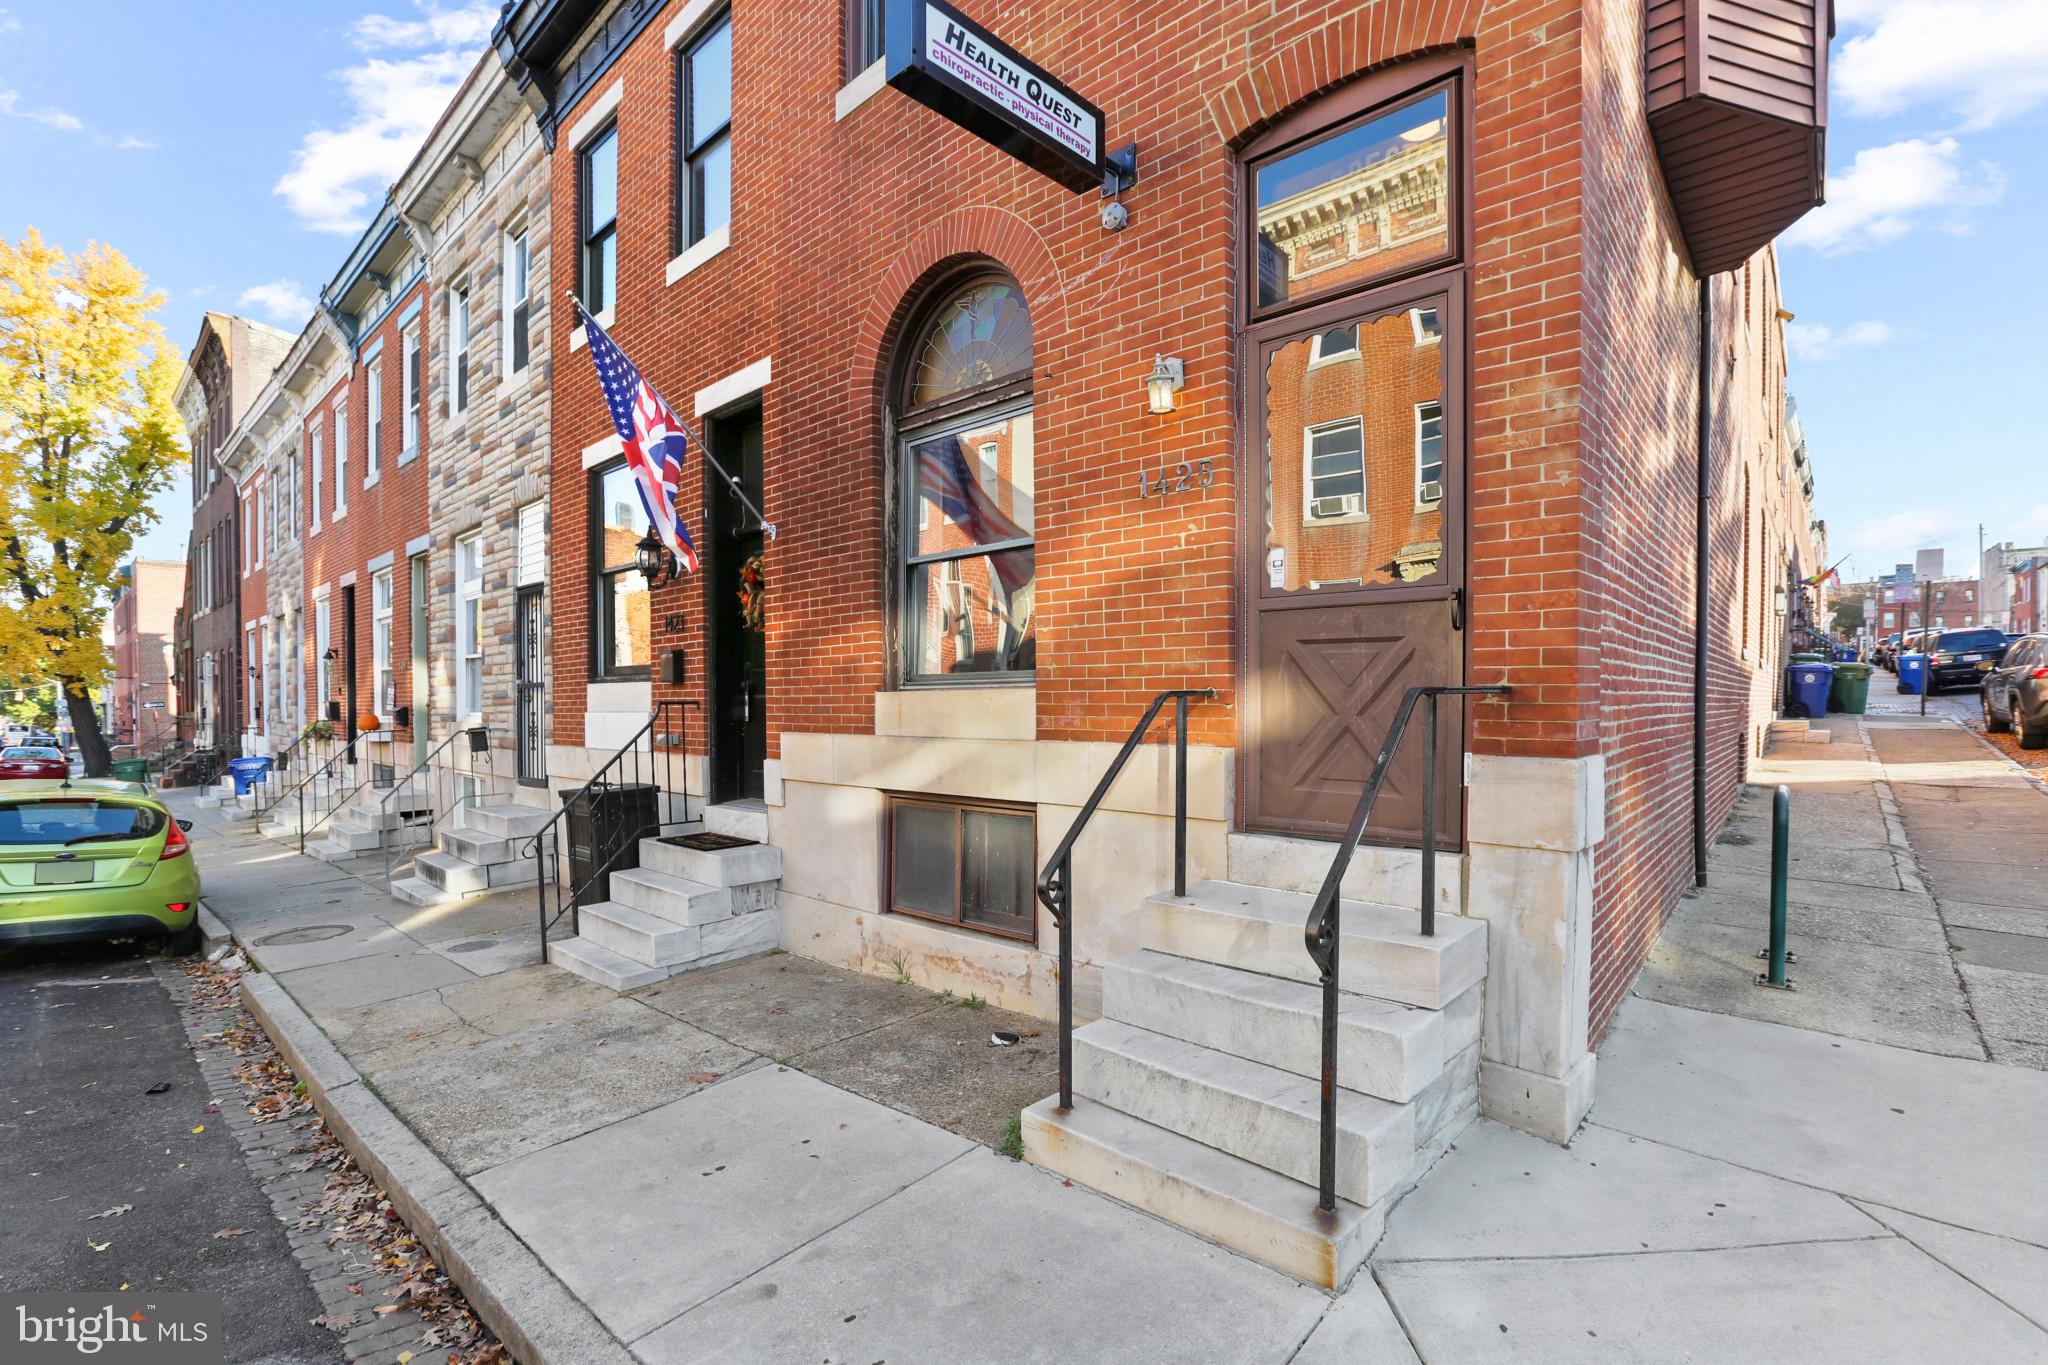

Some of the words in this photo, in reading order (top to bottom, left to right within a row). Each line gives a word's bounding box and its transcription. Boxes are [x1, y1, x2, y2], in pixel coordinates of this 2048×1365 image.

[932, 48, 1004, 100] chiropractic
[1012, 99, 1053, 132] physical
[1056, 126, 1091, 157] therapy
[945, 22, 1020, 89] HEALTH
[1026, 79, 1082, 128] QUEST
[1139, 458, 1214, 499] 1425
